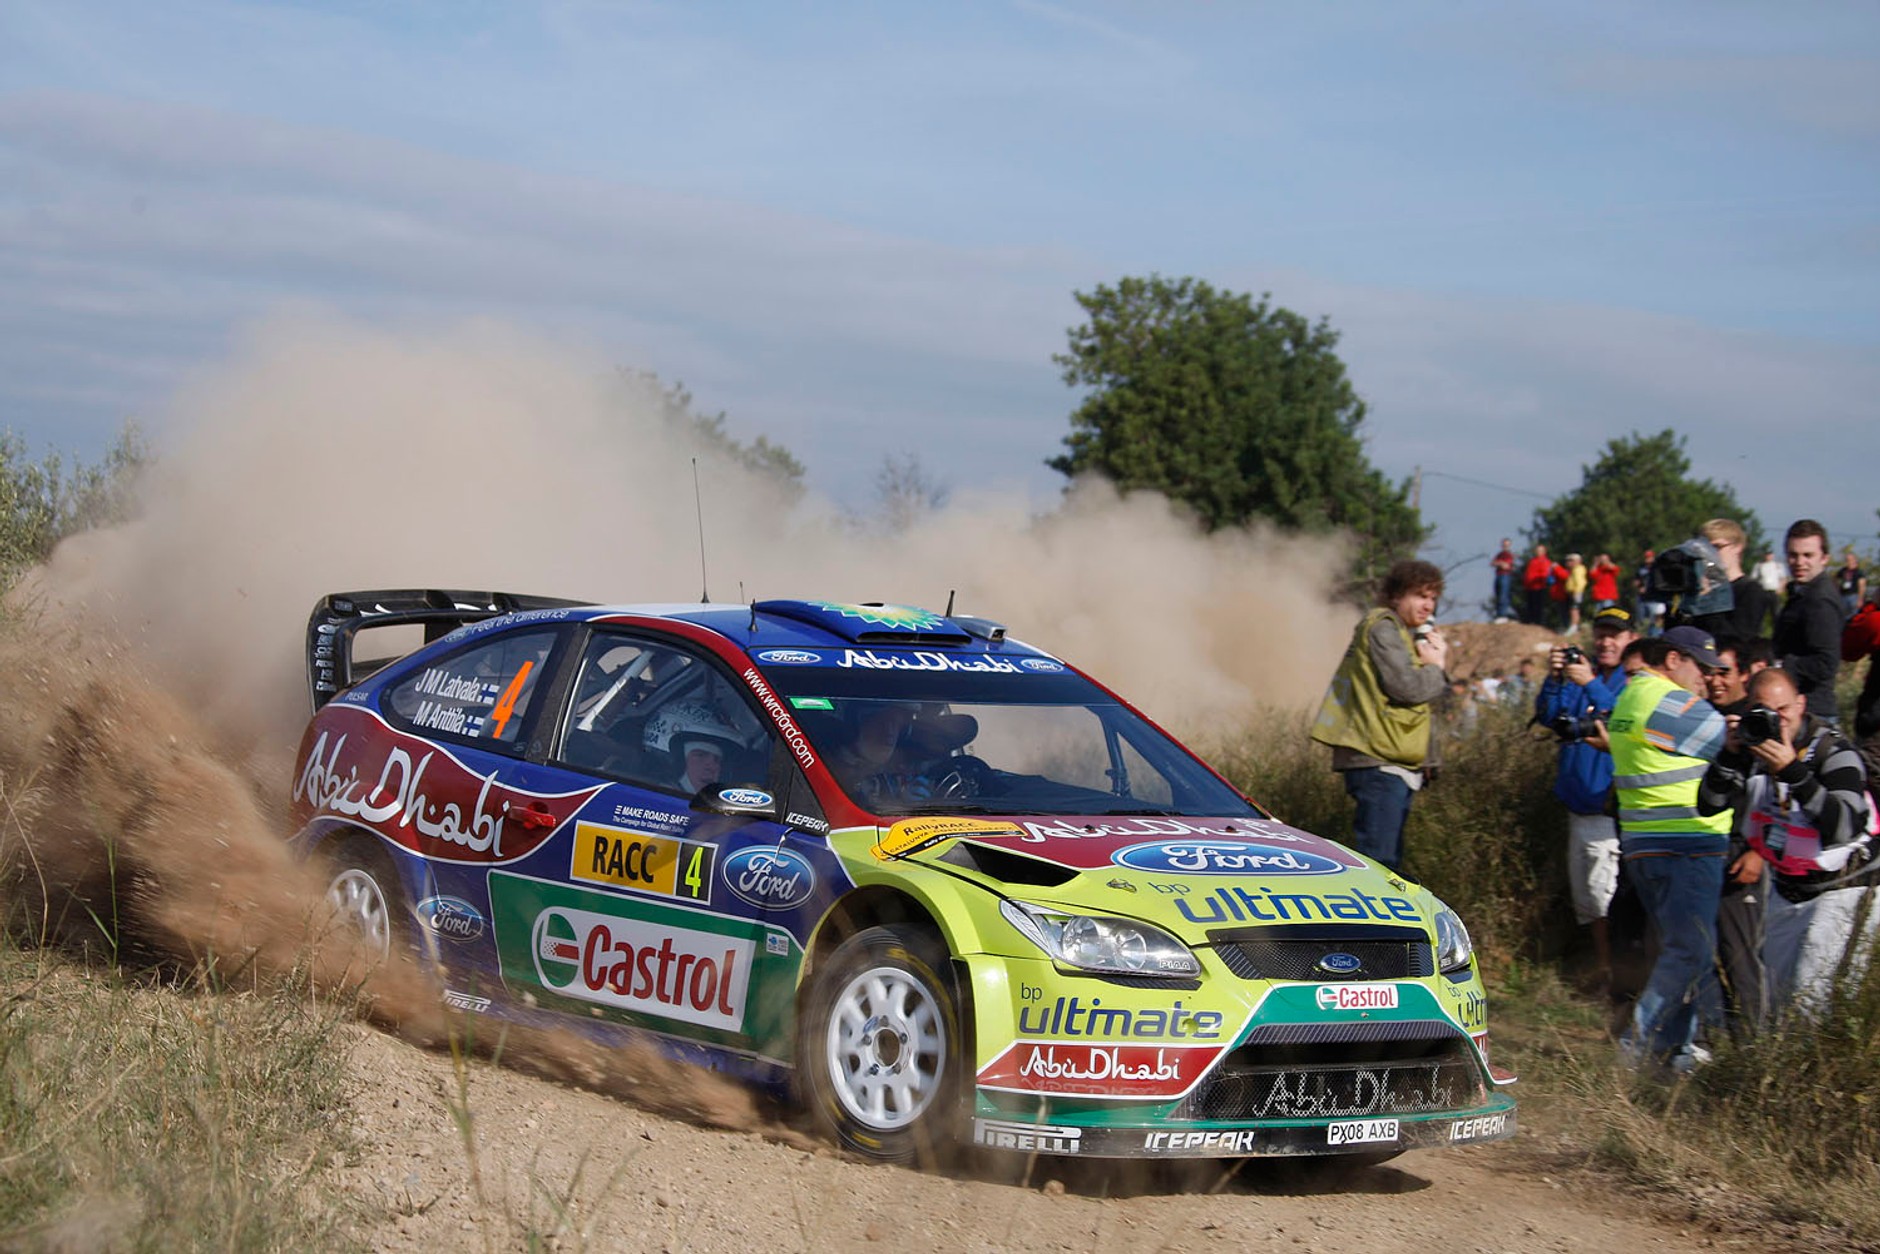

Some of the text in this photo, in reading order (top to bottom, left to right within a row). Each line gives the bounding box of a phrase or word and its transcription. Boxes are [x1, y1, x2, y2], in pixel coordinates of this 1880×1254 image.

[771, 652, 810, 661] Ford
[837, 649, 1024, 673] Abu Dhabi
[415, 668, 480, 702] J M Latvala
[491, 661, 534, 739] 4
[413, 701, 466, 734] M Anttila
[743, 667, 815, 768] www.wrcford.com
[293, 731, 510, 857] Abu Dhabi
[729, 789, 763, 803] Ford
[622, 806, 690, 826] MAKE ROADS SAFE
[786, 812, 828, 832] ICEPEAK
[1021, 818, 1315, 844] Abu Dhabi
[592, 835, 658, 884] RACC
[1161, 844, 1311, 869] Ford
[684, 846, 703, 898] 4
[738, 856, 801, 900] Ford
[1147, 882, 1191, 895] bp
[1174, 886, 1422, 923] ultimate
[431, 903, 483, 937] Ford
[583, 924, 738, 1017] Castrol
[1160, 960, 1191, 970] PIAA
[1332, 956, 1353, 967] Ford
[1021, 982, 1043, 1003] bp
[1339, 987, 1395, 1008] Castrol
[1018, 997, 1223, 1038] ultimate
[1020, 1045, 1180, 1080] Abu Dhabi
[1252, 1065, 1455, 1117] Abu Dhabi
[974, 1119, 1082, 1154] PIRELLI
[1145, 1130, 1255, 1151] ICEPEAK
[1330, 1119, 1397, 1144] PX08 AXB
[1450, 1116, 1507, 1141] ICEPEAK
